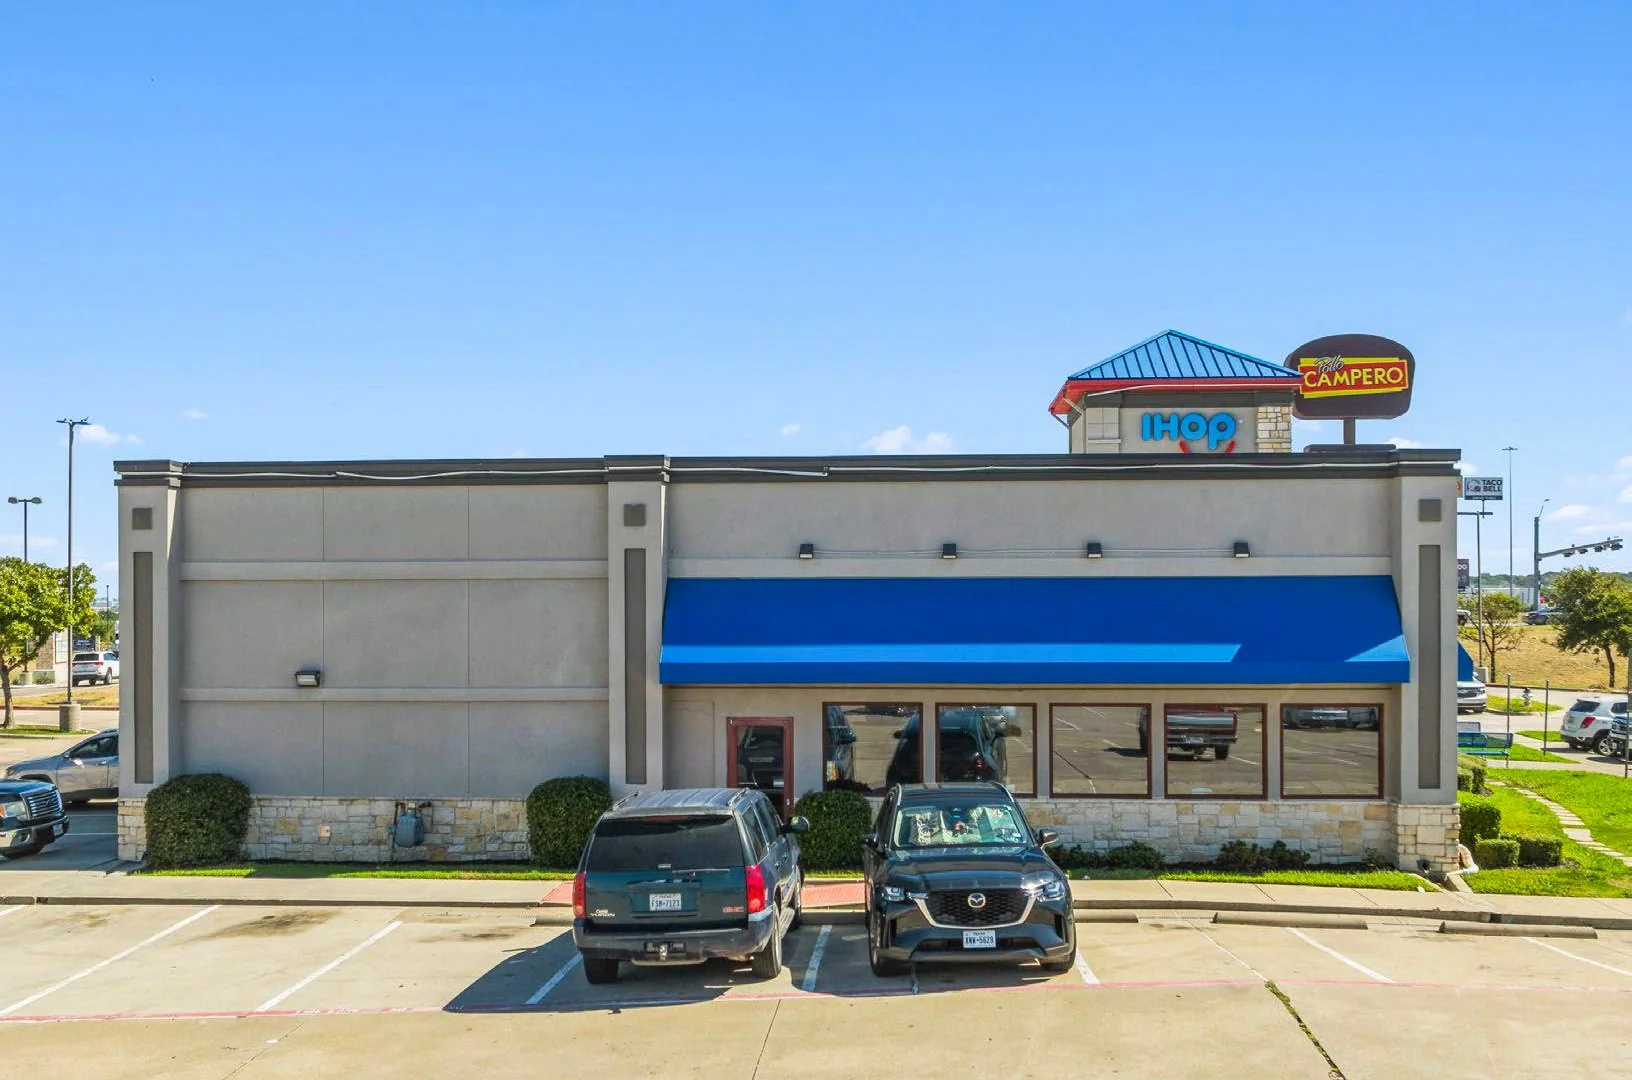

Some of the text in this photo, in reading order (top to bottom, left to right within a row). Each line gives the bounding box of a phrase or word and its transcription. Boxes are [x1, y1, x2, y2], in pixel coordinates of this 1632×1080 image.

[1314, 355, 1344, 373] Pollo
[1303, 367, 1404, 387] CAMPERO
[1141, 412, 1237, 450] IHOP
